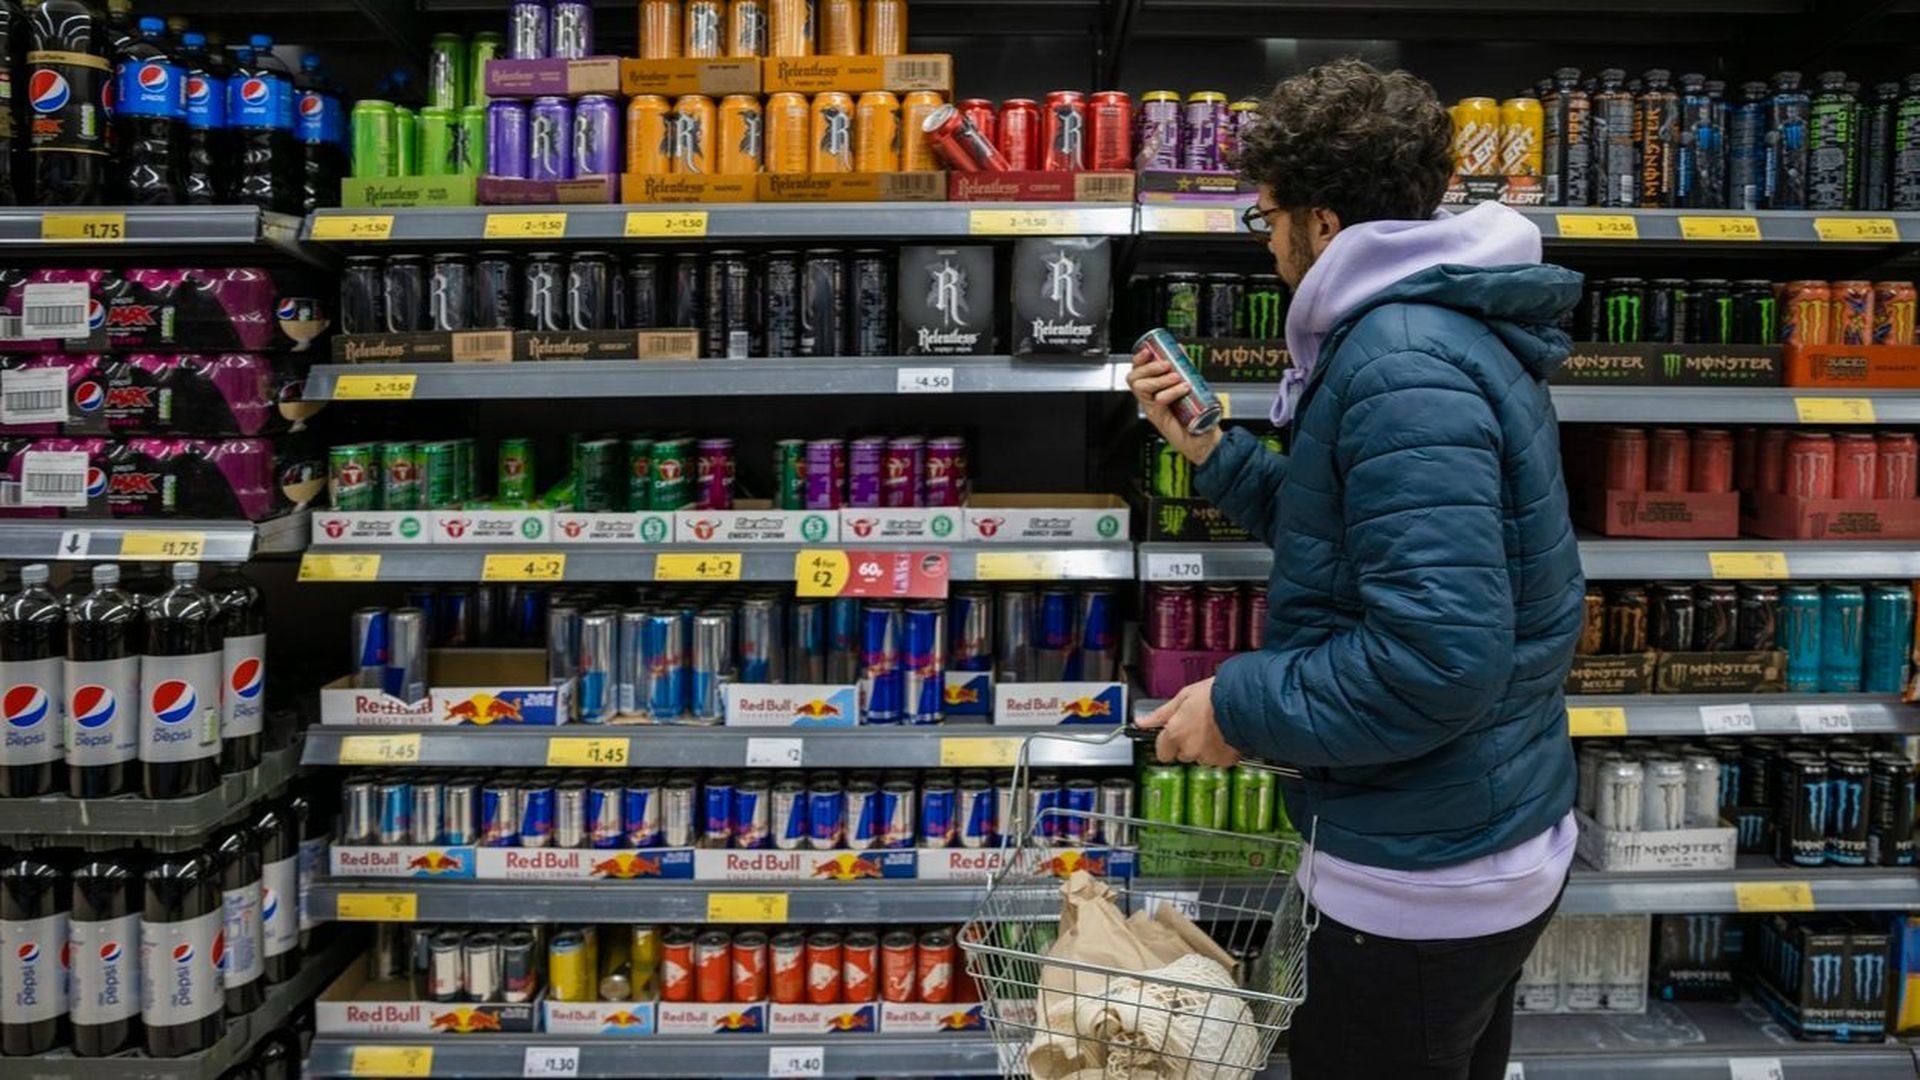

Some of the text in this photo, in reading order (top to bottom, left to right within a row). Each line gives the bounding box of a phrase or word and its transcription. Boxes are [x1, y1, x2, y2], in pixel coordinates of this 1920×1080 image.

[778, 62, 839, 84] Relentless
[645, 178, 705, 195] Relentless
[770, 177, 831, 194] Relentless
[959, 177, 1019, 196] Relentless
[364, 186, 420, 204] Relentless
[1499, 193, 1544, 204] ALERT
[84, 224, 120, 239] £1.75
[1046, 250, 1083, 318] R
[933, 258, 969, 327] R
[1032, 317, 1096, 344] Relentless
[918, 326, 981, 352] Relentless
[345, 340, 405, 362] Relentless
[529, 336, 590, 360] Relentless
[1210, 346, 1291, 368] MONST
[1686, 353, 1774, 371] MONSTER
[1231, 369, 1279, 377] ENER
[161, 541, 199, 556] £1.75
[523, 561, 534, 574] 4
[696, 561, 707, 574] 4
[812, 557, 821, 568] 4
[813, 571, 833, 587] £2
[1571, 668, 1637, 678] MONSTER
[1690, 663, 1762, 675] MONSTER
[740, 699, 792, 711] Red Bull
[1006, 698, 1058, 710] Red Bull
[5, 734, 46, 748] pepsi
[75, 734, 113, 747] pepsi
[153, 729, 192, 743] pepsi
[587, 748, 624, 763] £1.45
[1644, 842, 1723, 856] MONSTER
[340, 852, 399, 865] Red Bull
[506, 852, 579, 869] Red Bull
[727, 854, 800, 871] Red Bull
[950, 852, 986, 870] Red
[23, 964, 38, 1006] pepsi
[105, 964, 119, 1006] pepsi
[177, 965, 193, 1006] pepsi
[347, 1006, 421, 1022] Red Bull
[551, 1010, 597, 1021] Red Bull
[662, 1011, 708, 1022] Red Bull
[773, 1012, 821, 1022] Red Bull
[885, 1011, 932, 1022] Red Bull
[545, 1058, 575, 1071] £1.30
[789, 1058, 820, 1070] £1.40
